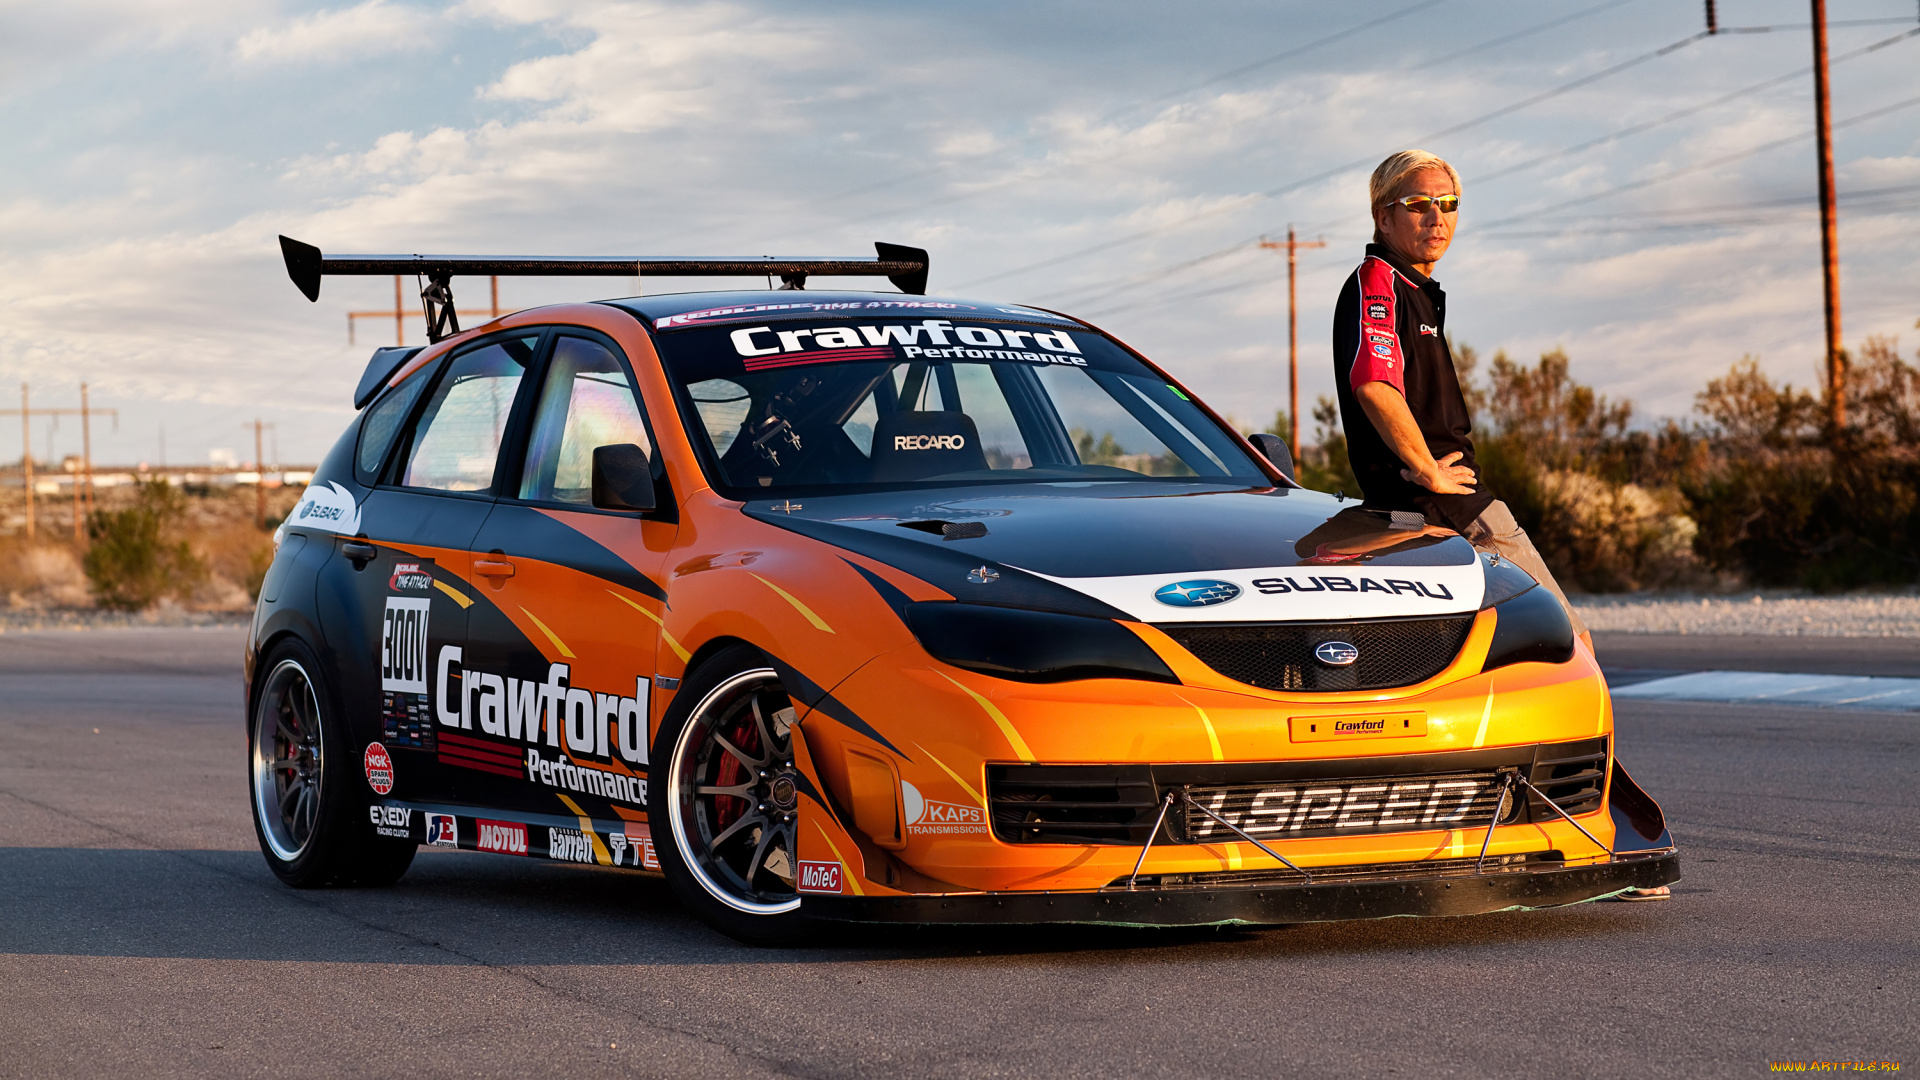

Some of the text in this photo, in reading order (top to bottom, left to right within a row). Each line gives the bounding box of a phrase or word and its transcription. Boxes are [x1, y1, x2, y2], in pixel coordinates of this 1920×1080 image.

[656, 302, 812, 330] REDLINE
[811, 301, 862, 311] TIME
[729, 319, 1084, 357] Crawford
[902, 345, 1089, 367] Performance
[894, 434, 965, 451] RECARO
[310, 505, 344, 520] SUBARU
[1251, 576, 1454, 600] SUBARU
[383, 608, 429, 682] 300V
[436, 644, 651, 766] Crawford
[1334, 719, 1384, 730] Crawford
[368, 755, 388, 768] NGK
[371, 770, 389, 778] SPARK
[372, 777, 390, 785] PLUGS
[527, 748, 648, 806] Performance
[370, 805, 411, 827] EXEDY
[929, 805, 980, 822] KAPS
[377, 827, 409, 837] RACING CLUTCH
[428, 815, 454, 845] JE
[478, 824, 527, 853] MOTUL
[907, 825, 988, 835] TRANSMISSIONS
[548, 826, 593, 864] Garrett
[802, 865, 838, 888] MoTeC
